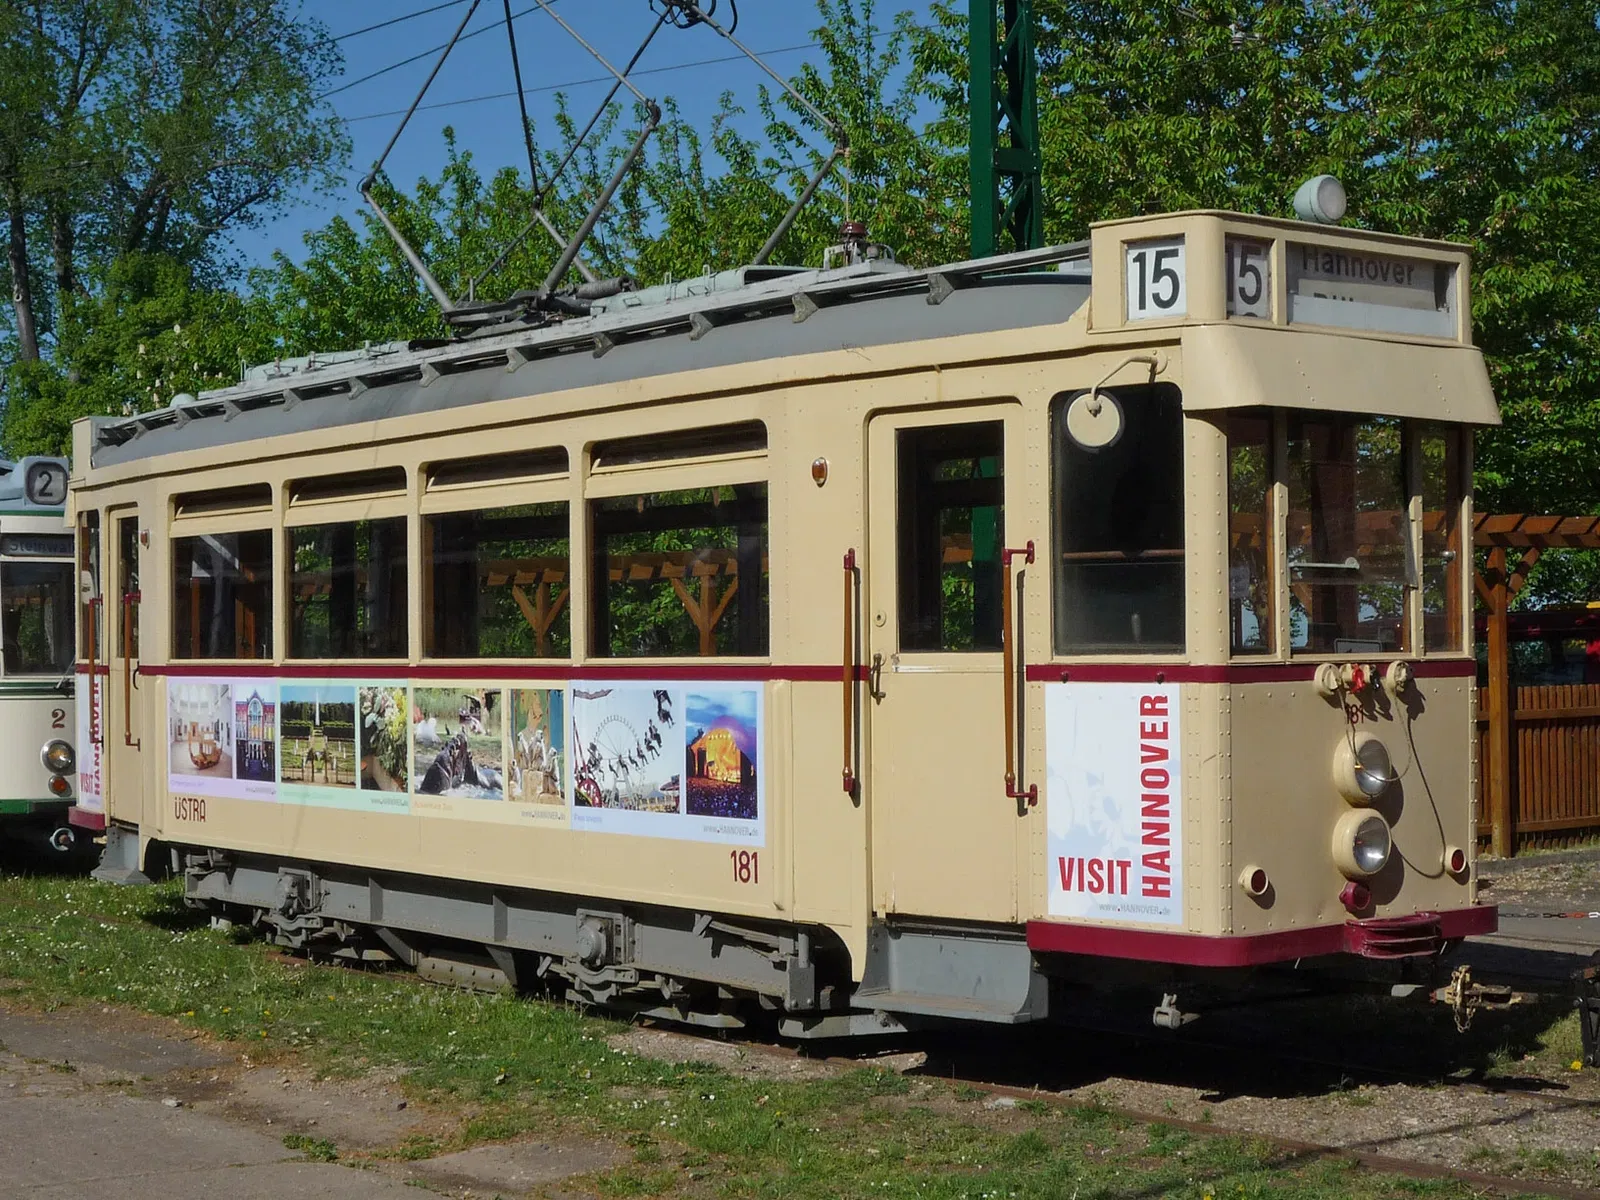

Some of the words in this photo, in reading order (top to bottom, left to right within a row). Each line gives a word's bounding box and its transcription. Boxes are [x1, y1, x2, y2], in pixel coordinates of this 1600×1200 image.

[1132, 248, 1180, 311] 15
[1303, 247, 1414, 285] Hannover
[39, 470, 53, 497] 2
[51, 708, 66, 729] 2
[1140, 695, 1171, 899] HANNOVER
[730, 850, 758, 884] 181
[1058, 856, 1132, 895] VISIT
